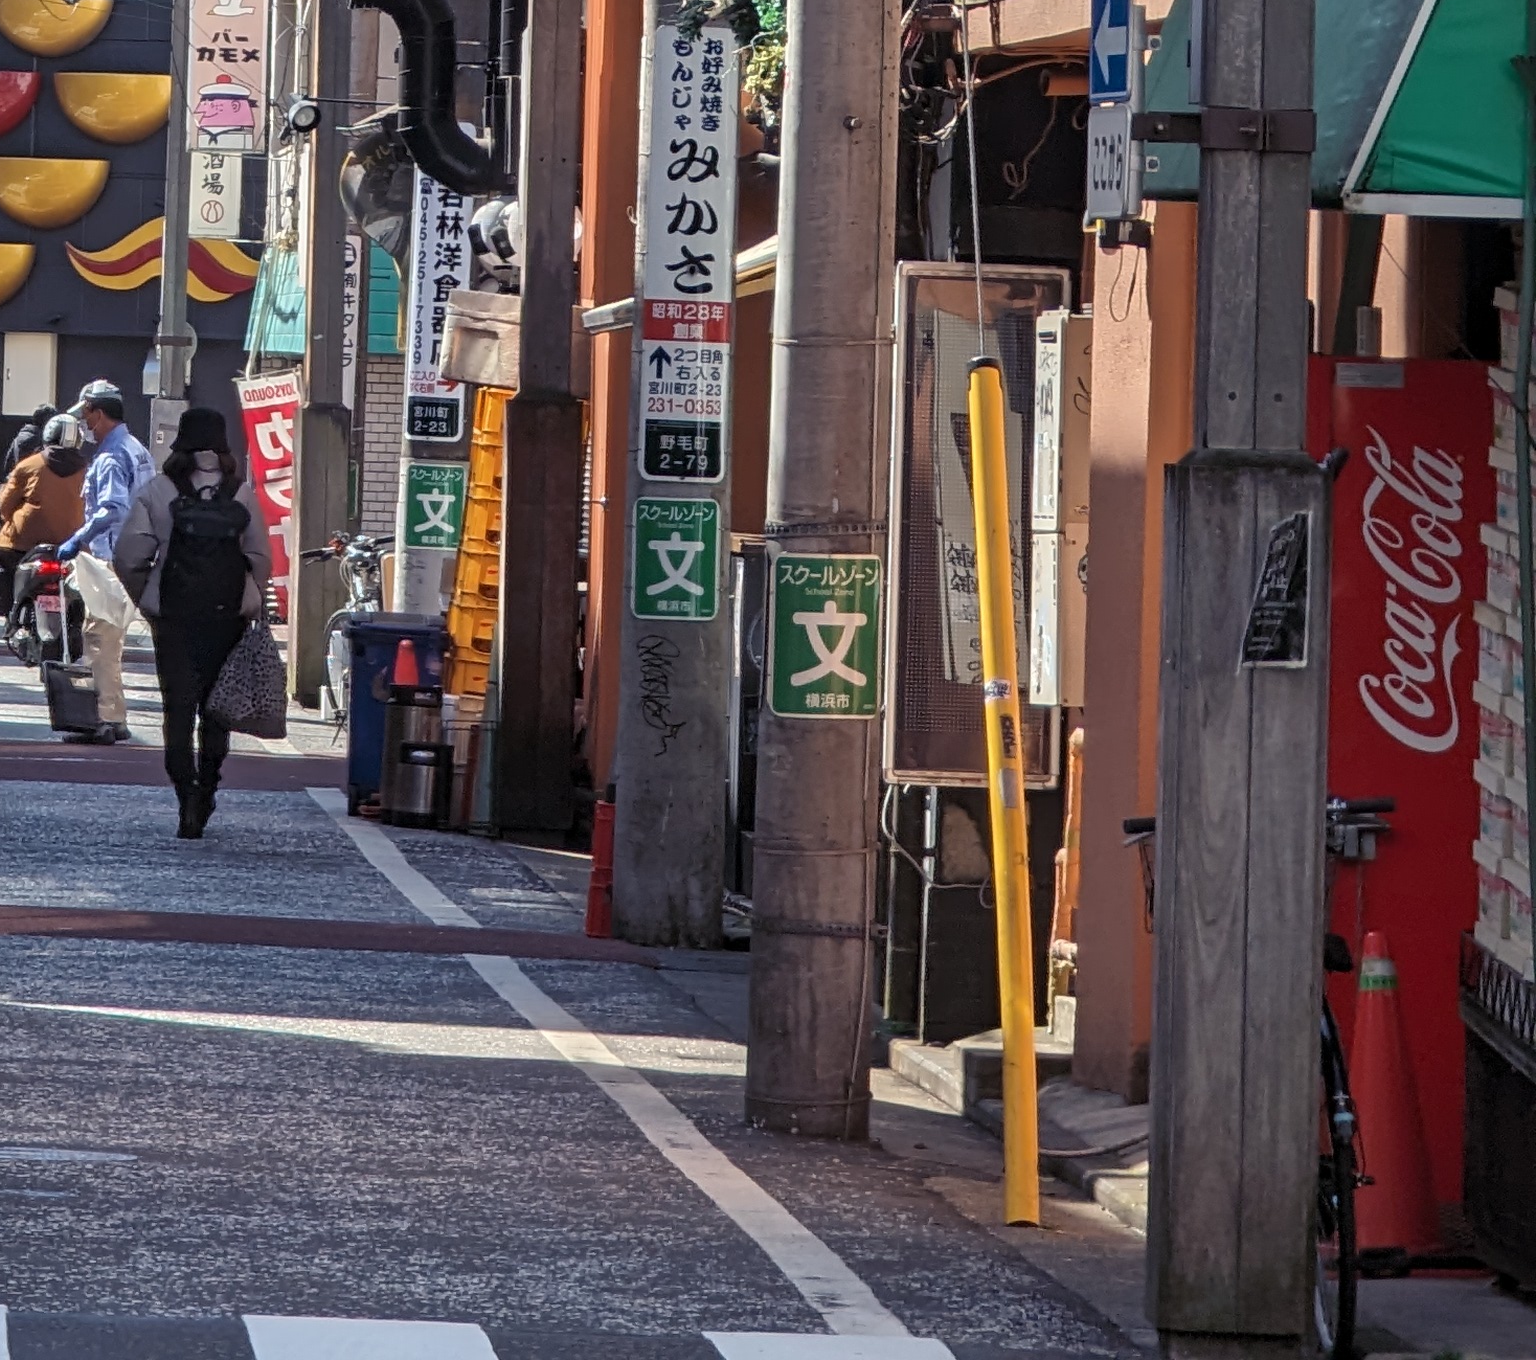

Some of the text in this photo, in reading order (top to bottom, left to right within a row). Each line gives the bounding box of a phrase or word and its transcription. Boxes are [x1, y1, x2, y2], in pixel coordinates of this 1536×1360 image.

[212, 28, 249, 44] バー
[196, 47, 260, 63] カモメ
[672, 37, 693, 130] もんじゃ
[700, 38, 724, 132] お好み焼き
[665, 138, 720, 294] みかさ
[652, 303, 724, 322] 昭和28年
[673, 323, 703, 339] 創業
[674, 348, 723, 365] 2つ目角
[676, 366, 721, 380] 右入る
[648, 382, 722, 396] 宮川町2-23
[413, 406, 449, 419] 宮川町
[648, 397, 722, 415] 231-0353
[414, 420, 447, 433] 2-23
[659, 435, 709, 451] 野毛町
[660, 454, 708, 470] 2-79
[414, 488, 456, 533] 文
[646, 531, 705, 596] 文
[780, 564, 879, 586] スクールゾーン
[1359, 424, 1464, 753] Coca-Cola
[790, 600, 868, 687] 文
[805, 692, 850, 708] 横浜市
